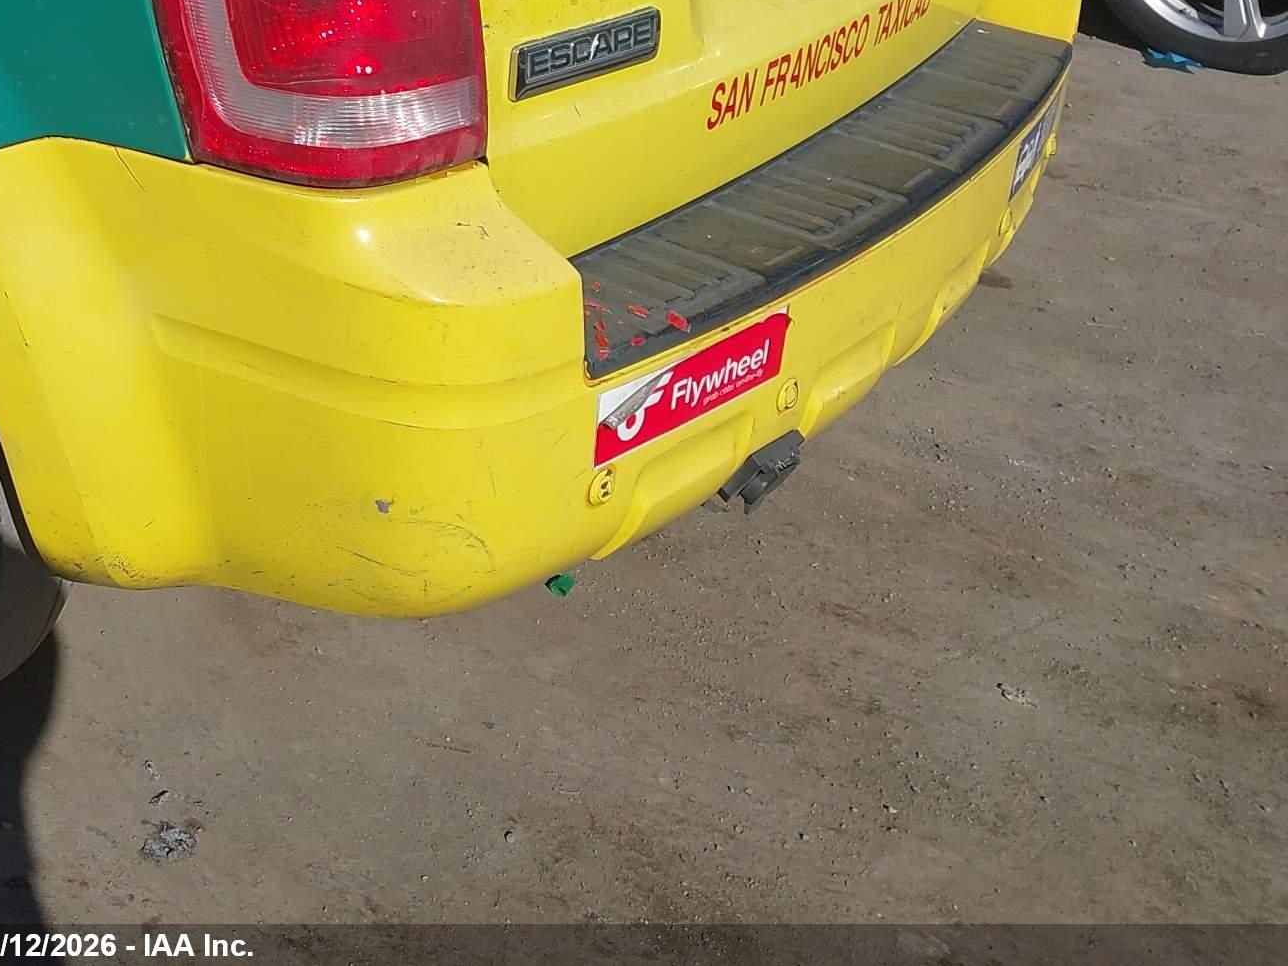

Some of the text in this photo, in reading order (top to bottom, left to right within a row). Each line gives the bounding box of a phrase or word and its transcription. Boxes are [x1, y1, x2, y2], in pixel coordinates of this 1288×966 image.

[527, 17, 654, 81] ESCAPE
[706, 68, 759, 130] SAN
[759, 13, 870, 107] FRANCISCO
[670, 338, 770, 411] Flywheel
